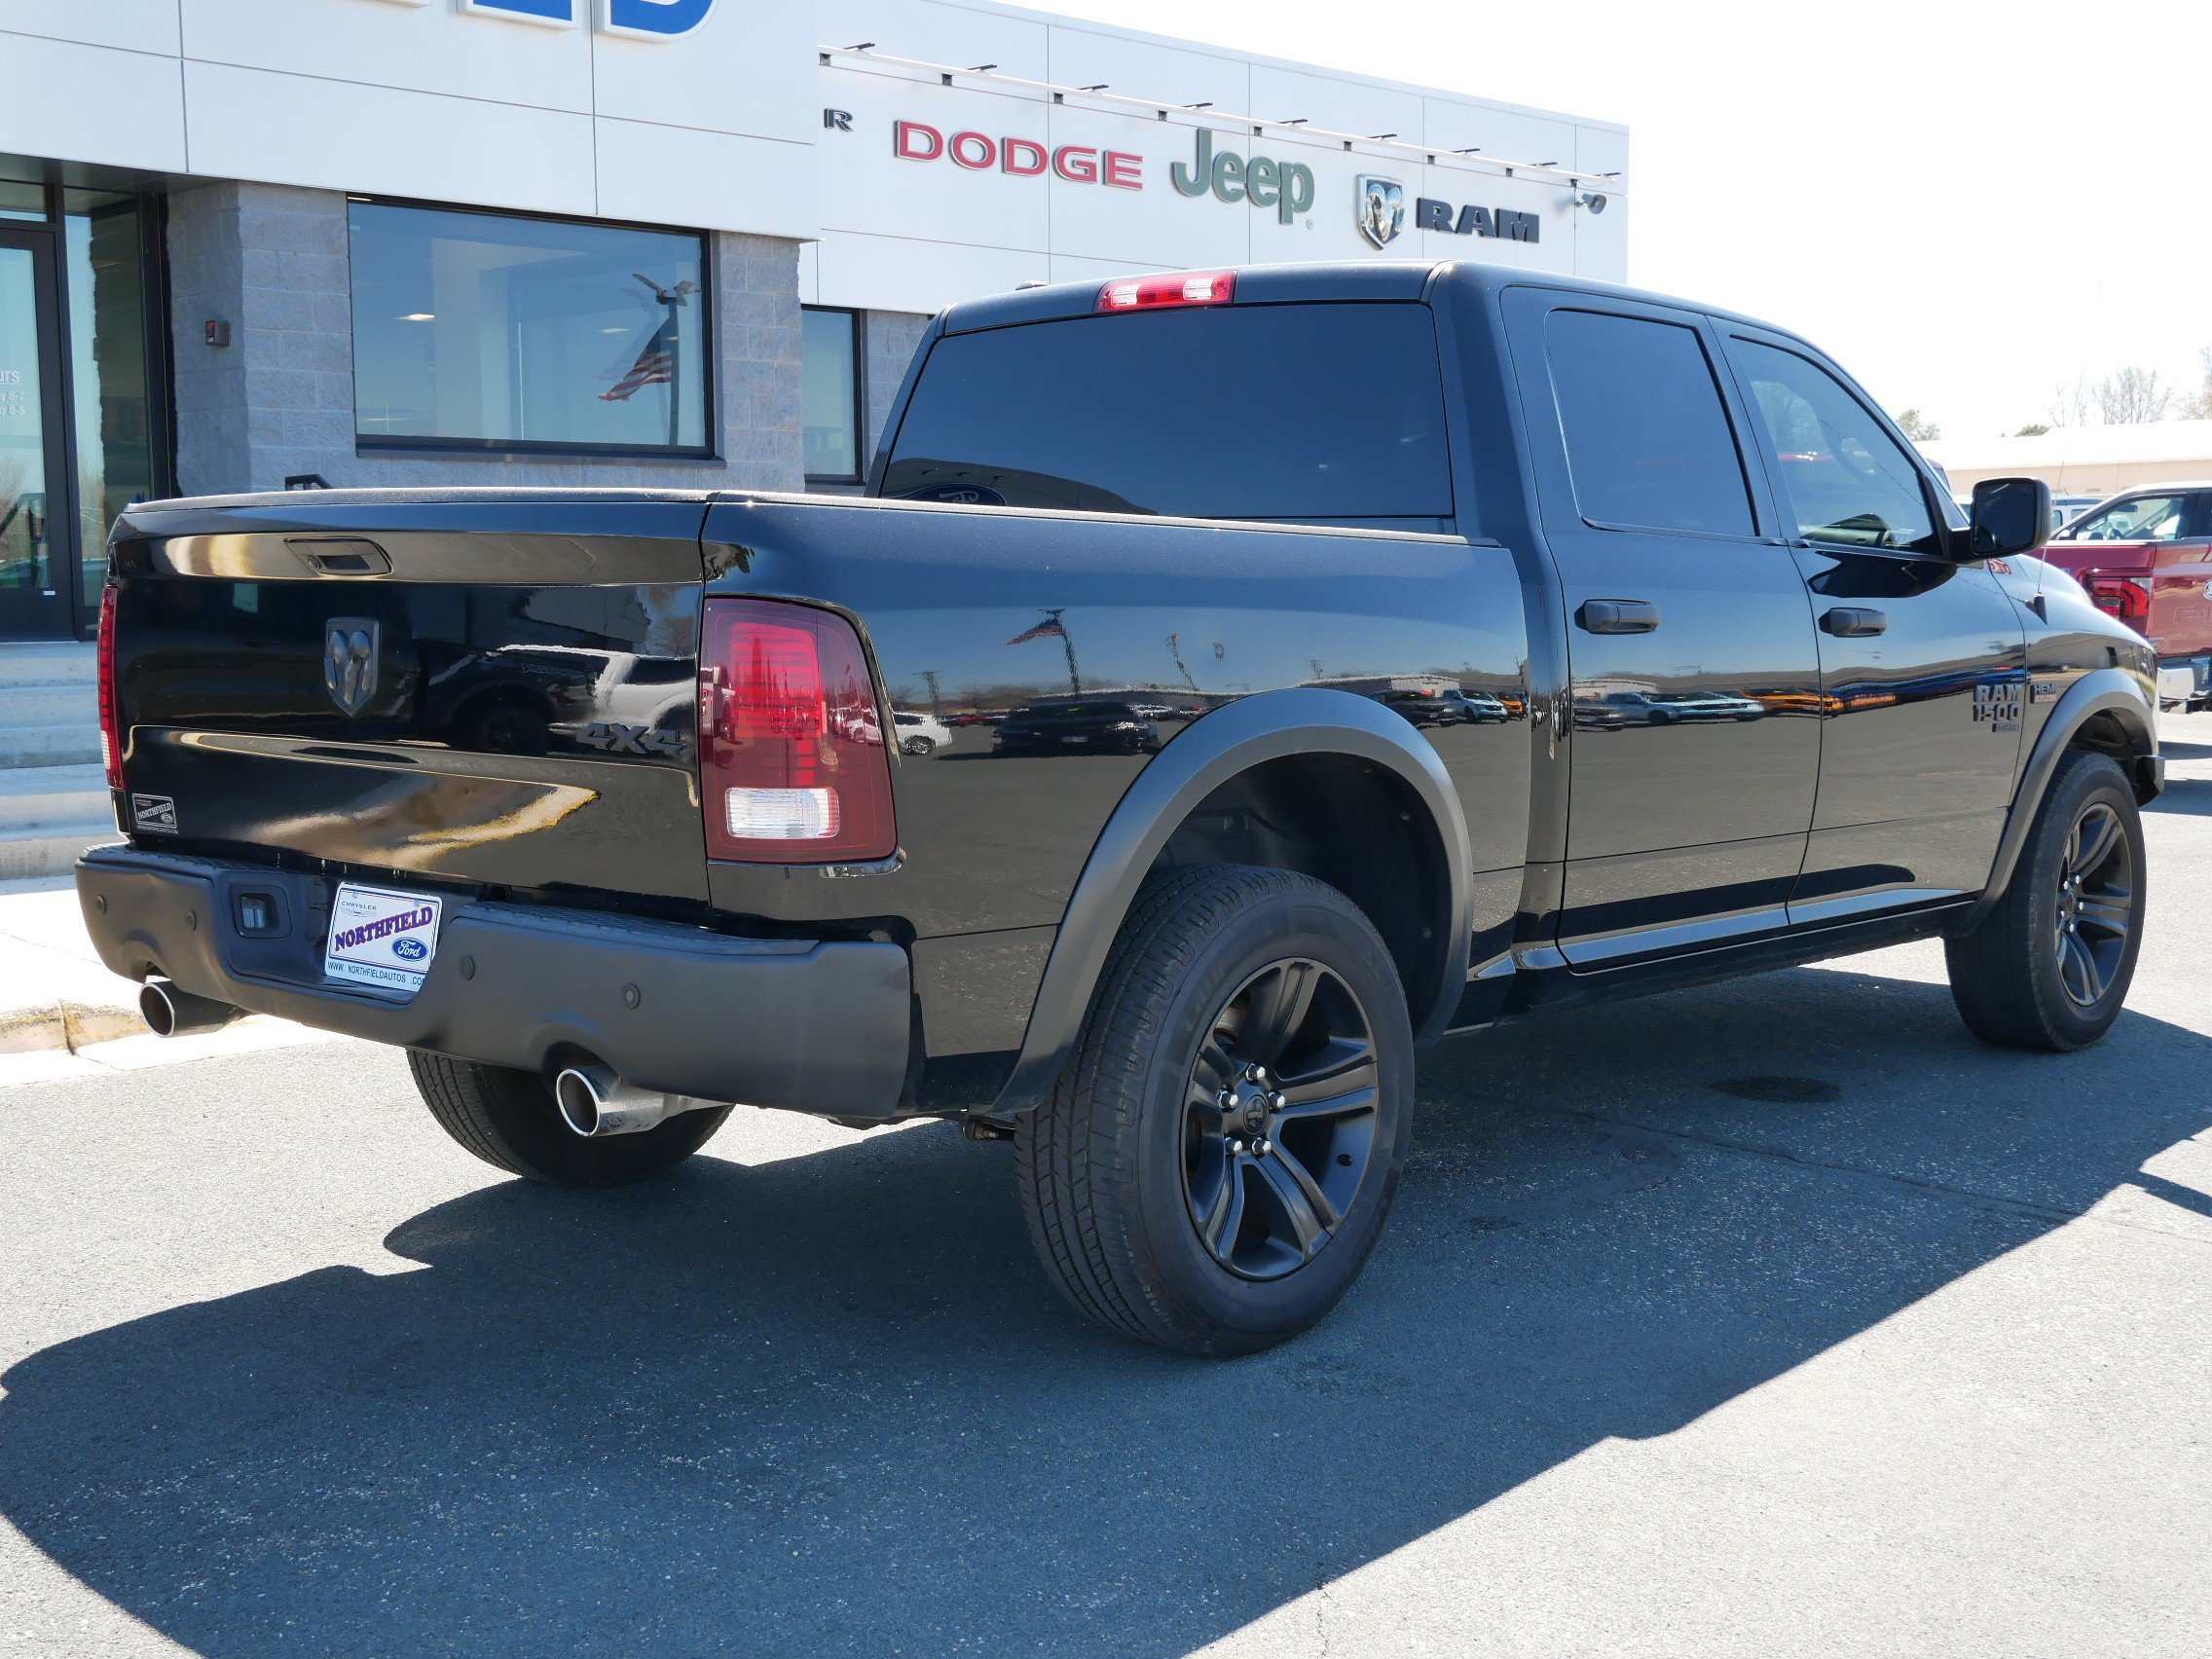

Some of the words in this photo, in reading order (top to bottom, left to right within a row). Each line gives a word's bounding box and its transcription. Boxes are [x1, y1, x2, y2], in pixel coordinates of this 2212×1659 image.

[894, 119, 1144, 191] DODGE
[1170, 128, 1315, 225] Jeep
[1417, 197, 1540, 243] RAM
[1973, 684, 2022, 702] RAM
[1972, 704, 2020, 721] 1500
[137, 802, 172, 820] NORTHFIELD
[341, 901, 377, 911] CHRYSLER
[334, 906, 433, 951] NORTHFIELD
[397, 940, 422, 958] Ford
